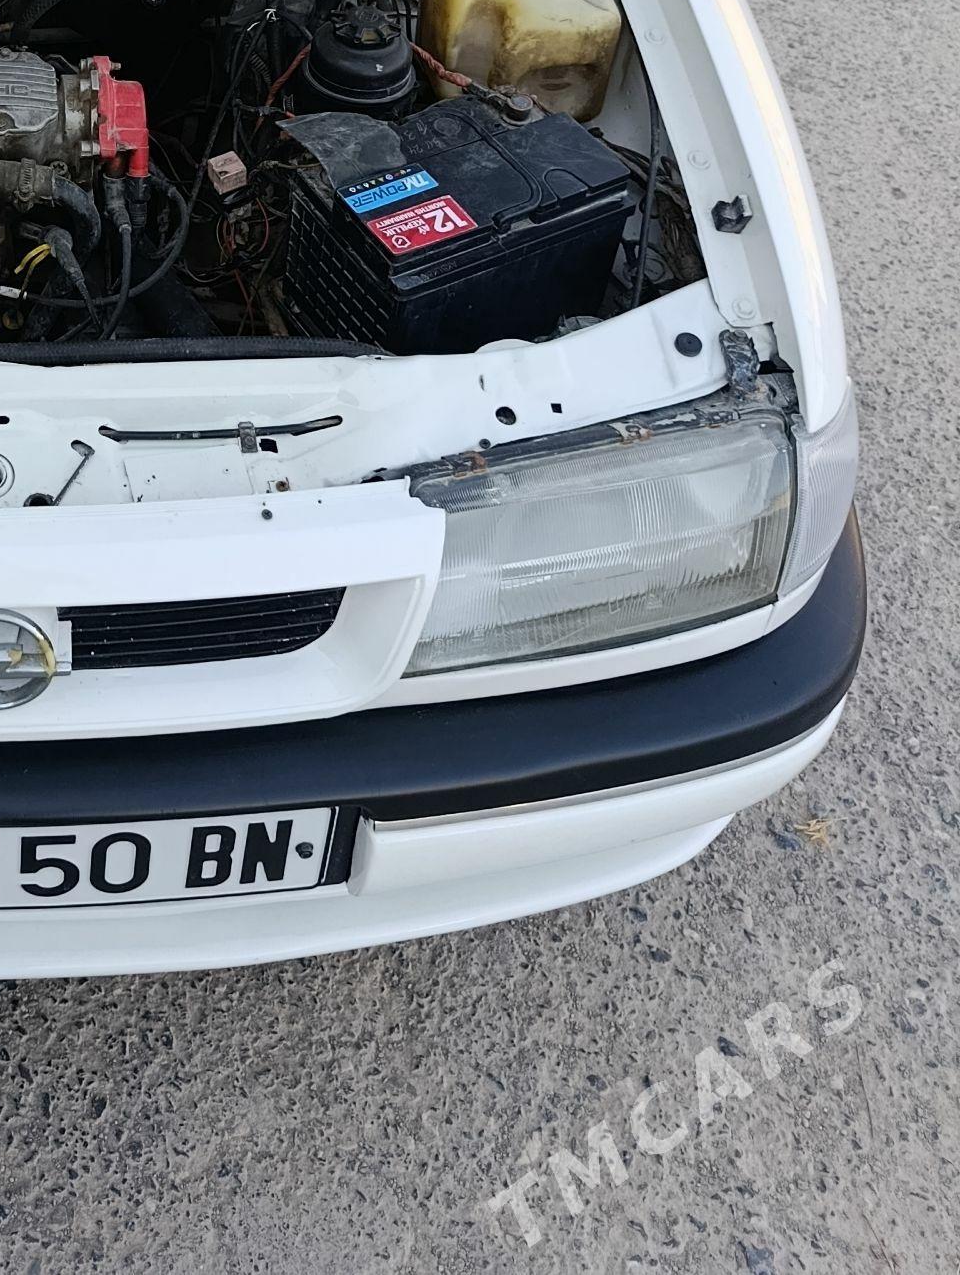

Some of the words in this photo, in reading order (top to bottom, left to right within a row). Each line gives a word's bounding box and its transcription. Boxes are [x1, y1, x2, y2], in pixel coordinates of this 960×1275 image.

[415, 200, 447, 213] MONTHS
[375, 210, 417, 229] WARRANTY
[422, 206, 469, 233] 12
[184, 819, 294, 889] BN
